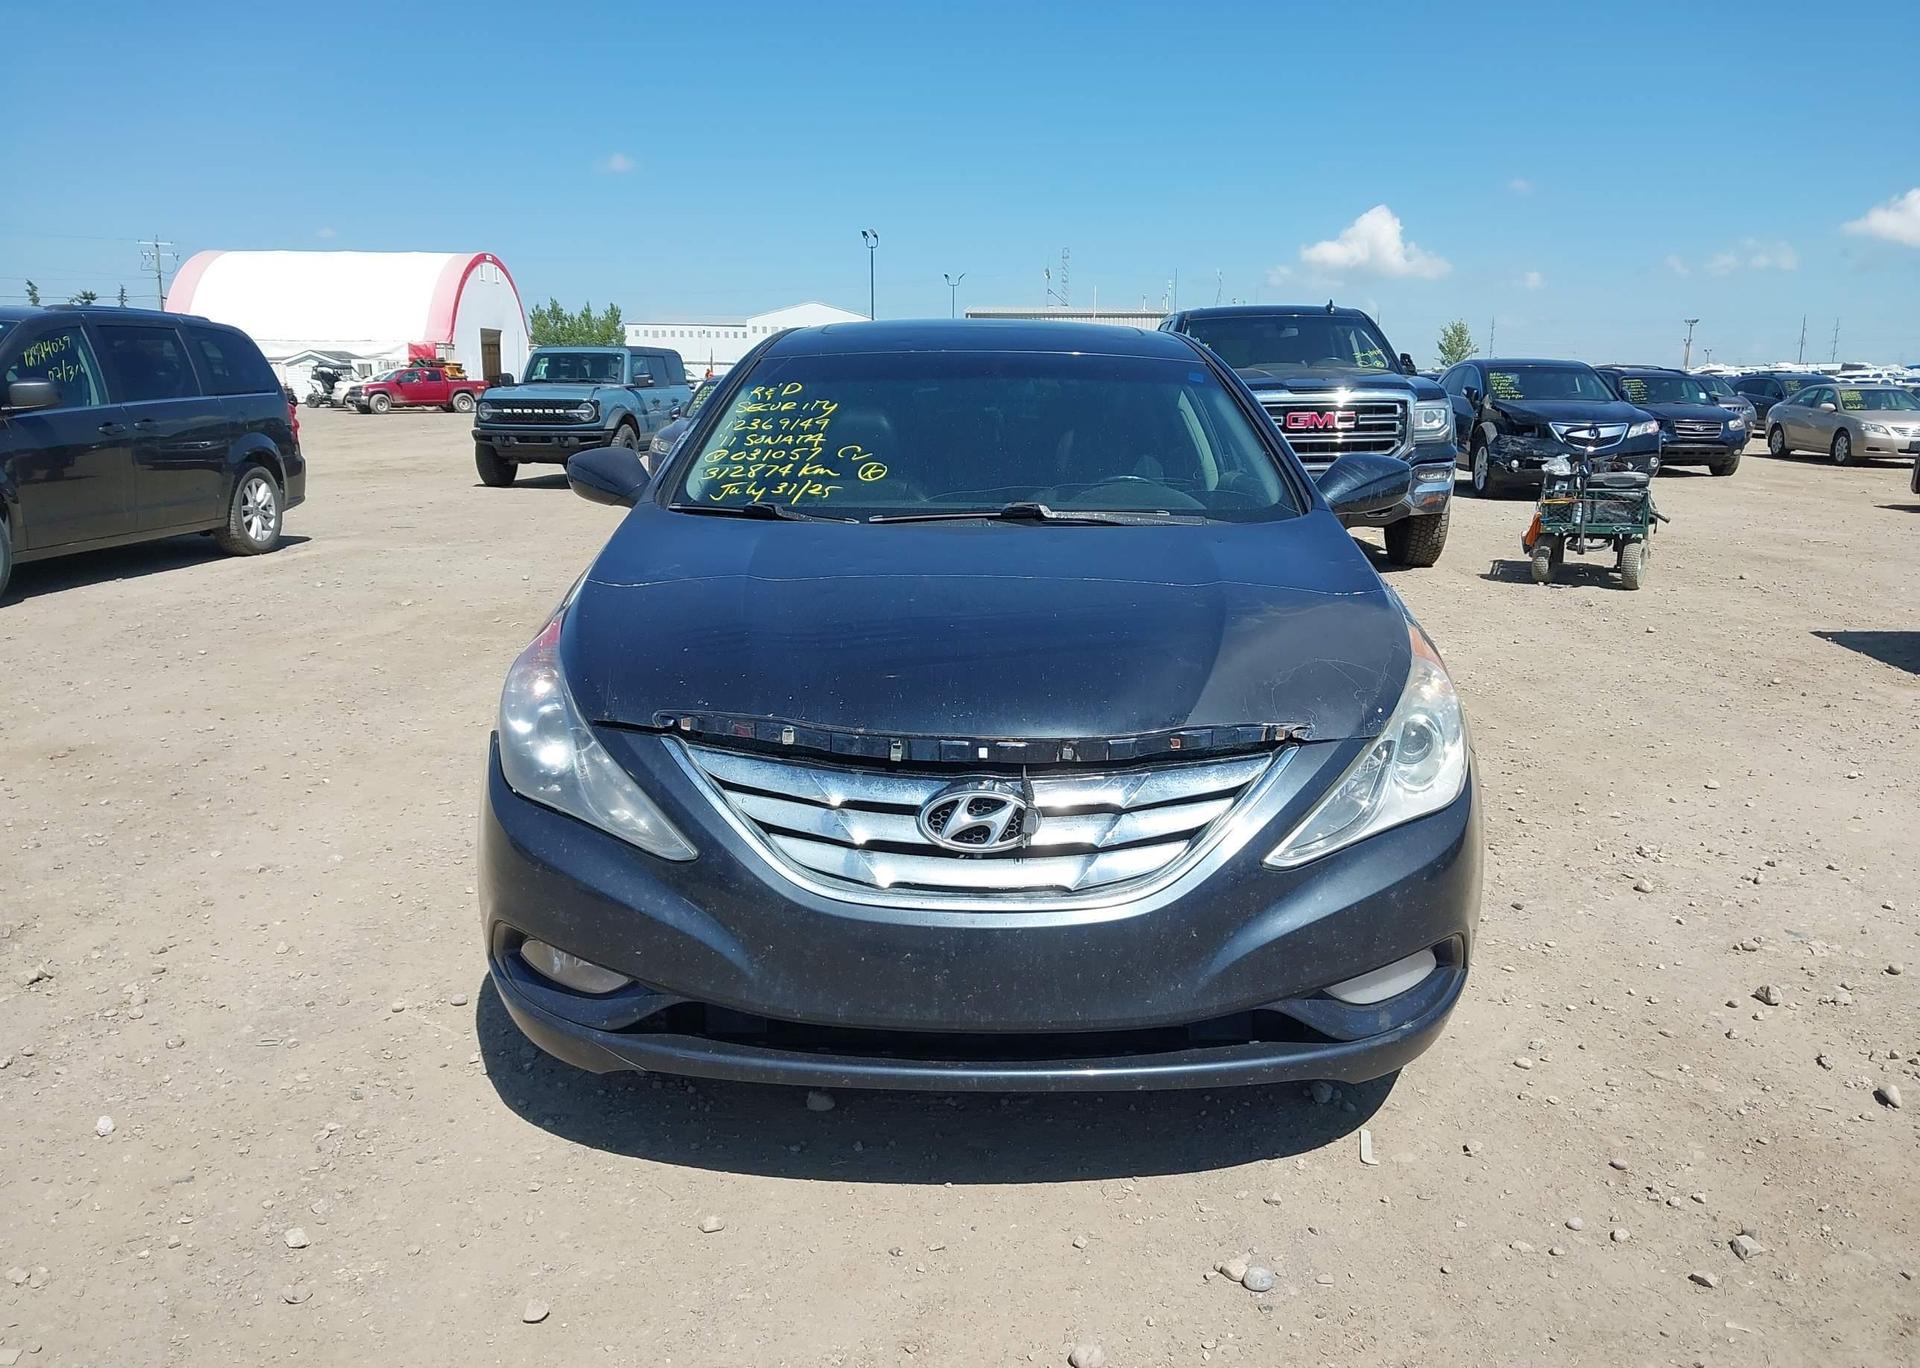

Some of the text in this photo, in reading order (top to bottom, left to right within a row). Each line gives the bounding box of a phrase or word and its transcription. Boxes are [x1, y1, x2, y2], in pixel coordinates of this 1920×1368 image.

[735, 400, 839, 420] SECURITY
[725, 417, 831, 431] 12369149
[1286, 411, 1356, 429] GMC
[743, 433, 827, 448] SONATA
[702, 463, 795, 480] 312874
[709, 479, 844, 505] July 31/25
